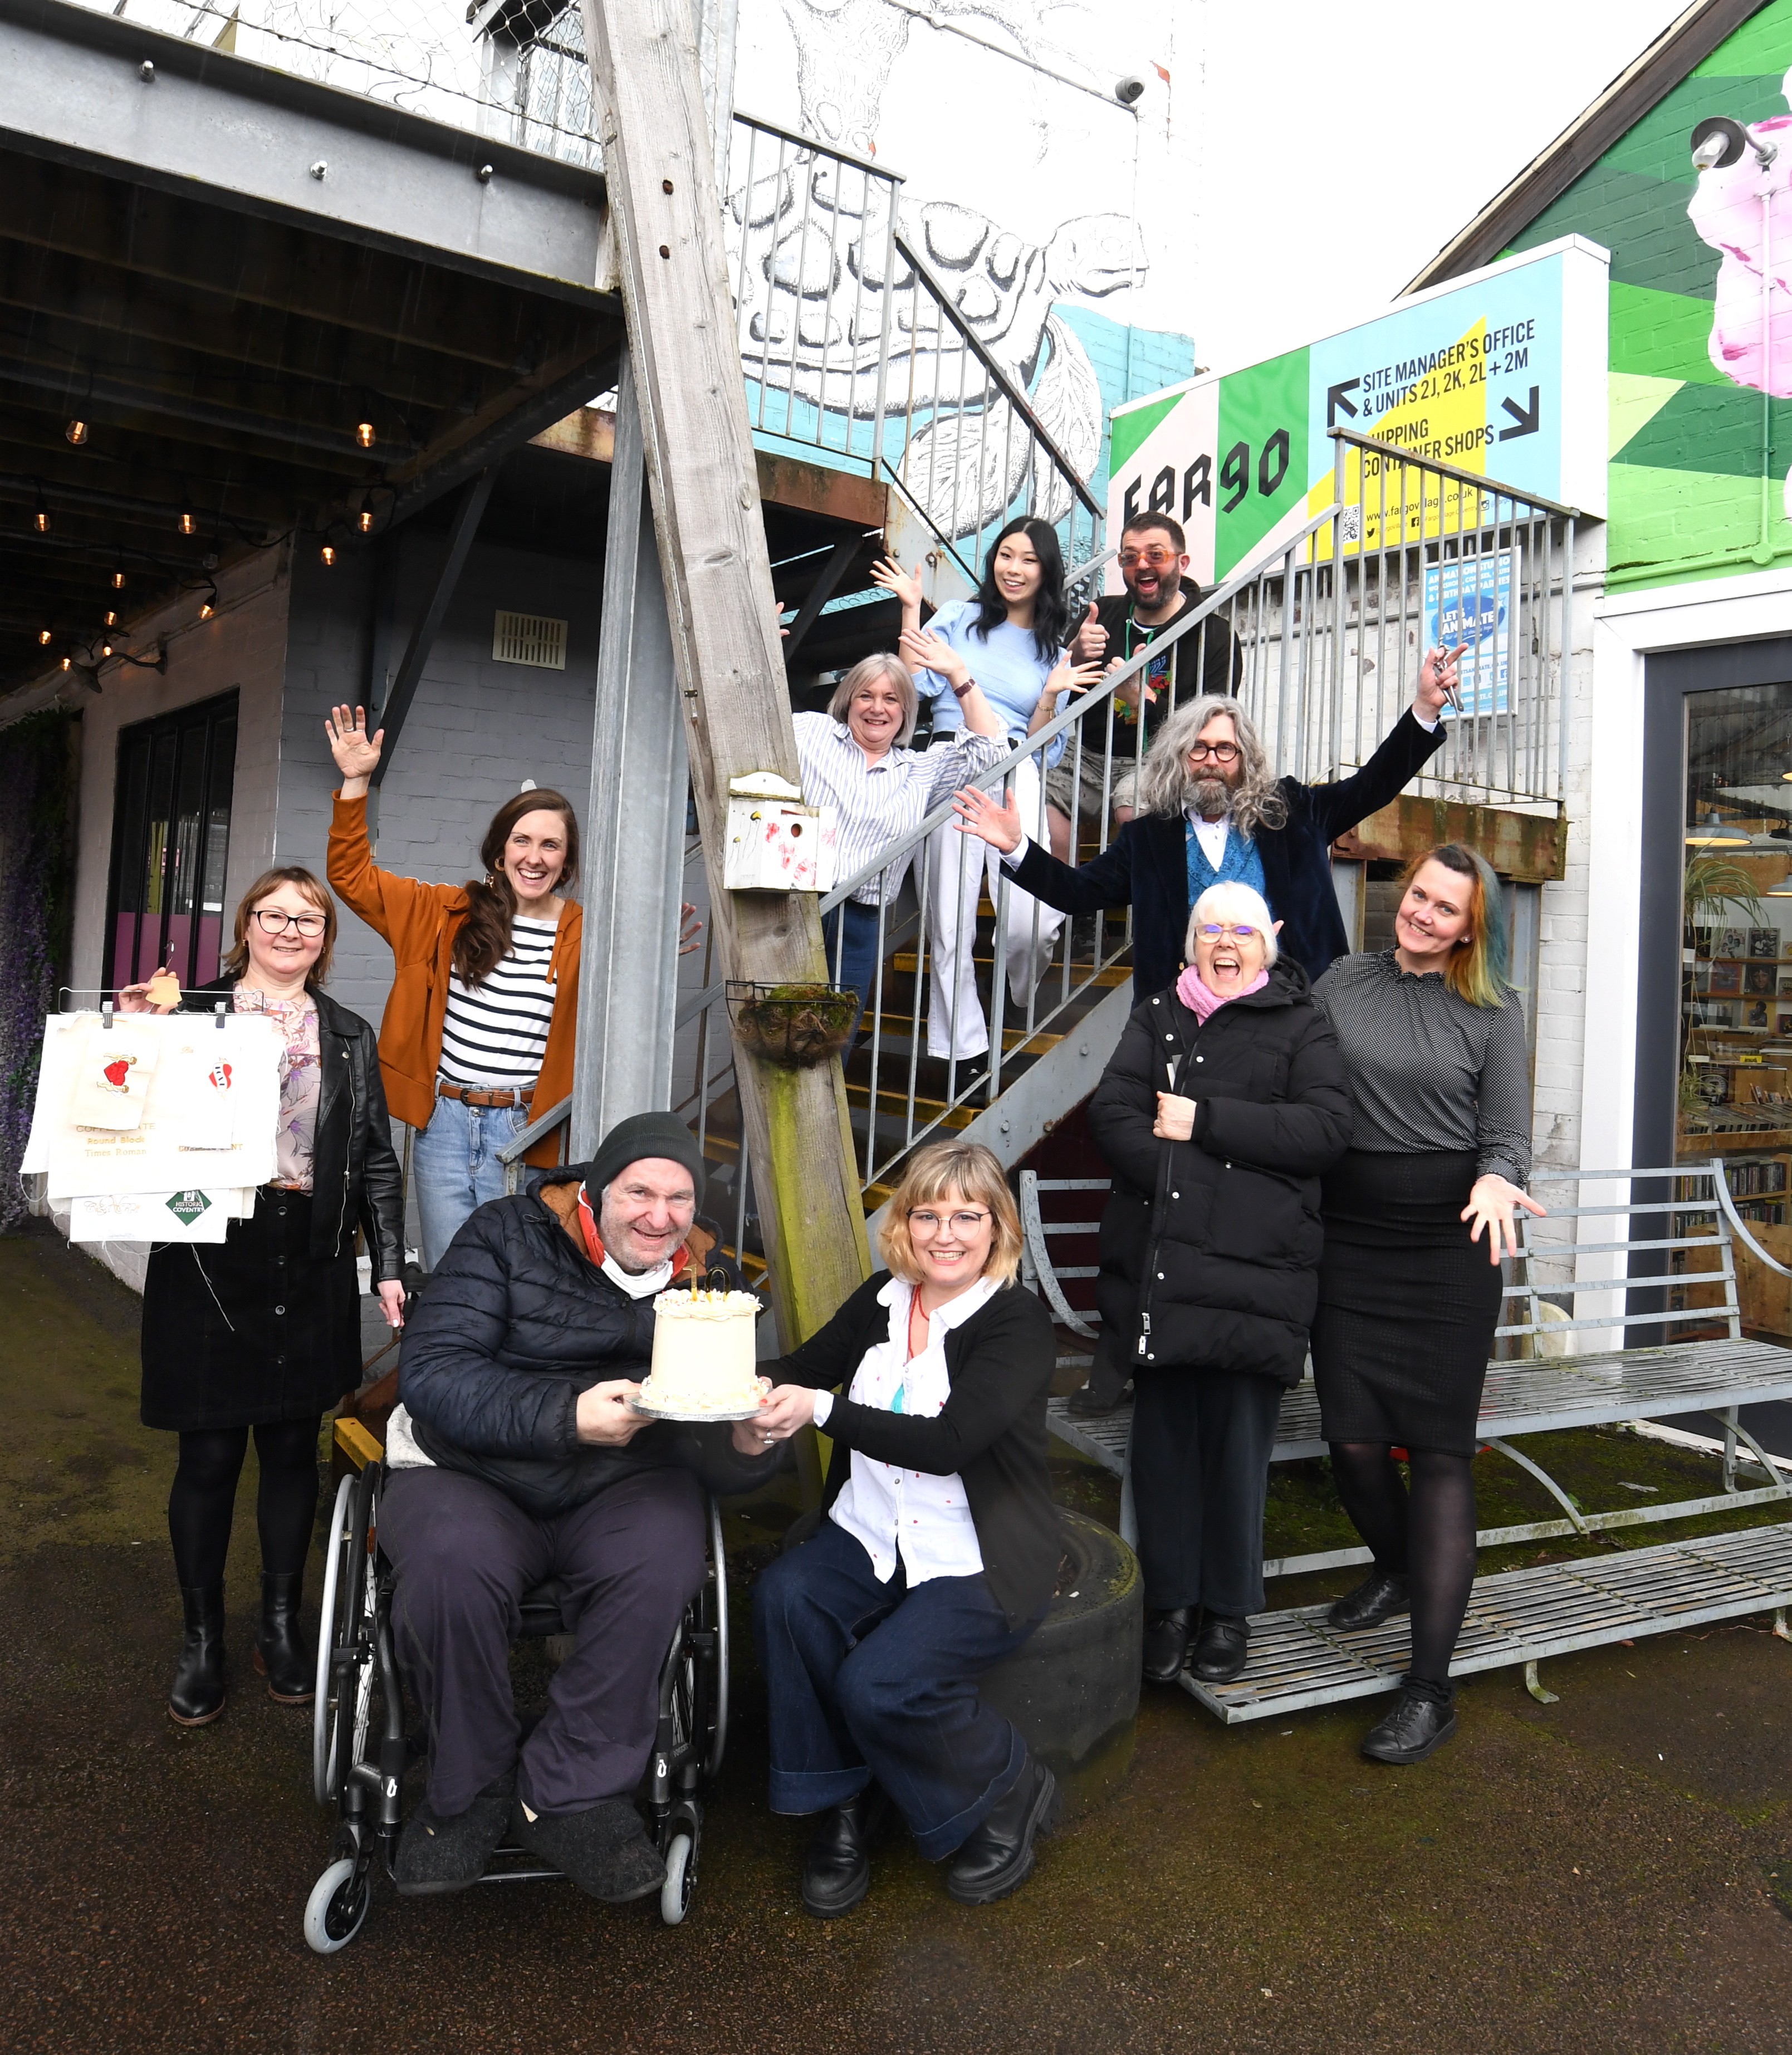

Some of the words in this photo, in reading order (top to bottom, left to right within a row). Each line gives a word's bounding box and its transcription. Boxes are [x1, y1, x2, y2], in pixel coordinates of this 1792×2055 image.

[1363, 366, 1392, 393] SITE
[1395, 337, 1480, 384] MANAGER'S
[1483, 318, 1535, 355] OFFICE
[1363, 398, 1373, 417] &
[1376, 383, 1418, 413] UNITS
[1443, 368, 1466, 390] 2K,
[1469, 361, 1487, 385] 2L
[1489, 361, 1502, 376] +
[1504, 347, 1528, 374] 2M
[1445, 424, 1495, 457] SHOPS
